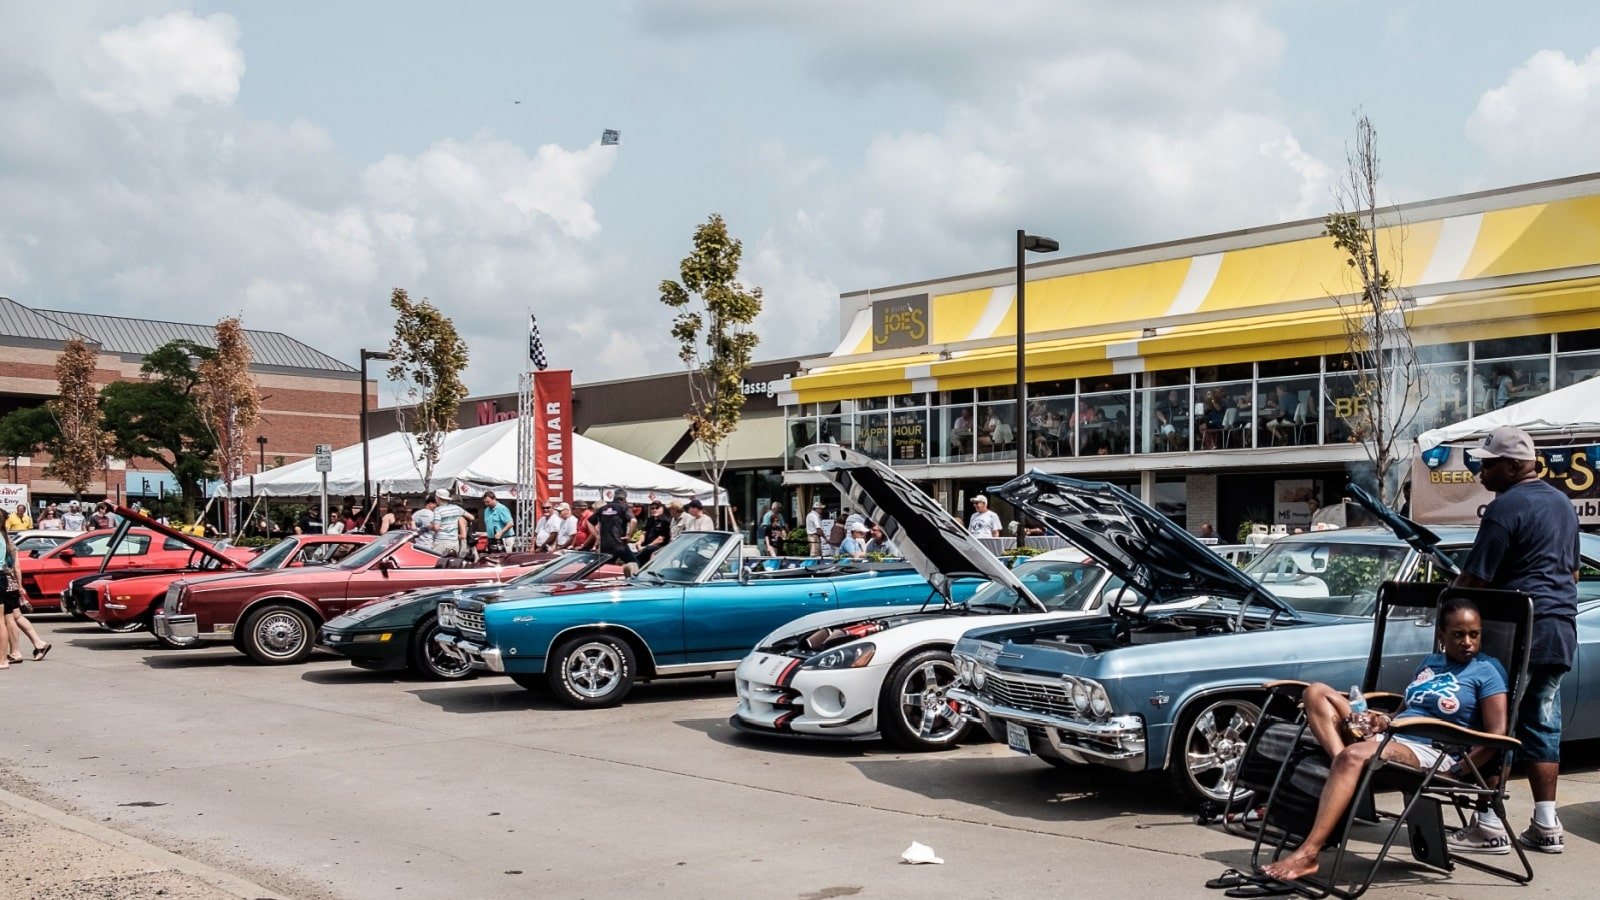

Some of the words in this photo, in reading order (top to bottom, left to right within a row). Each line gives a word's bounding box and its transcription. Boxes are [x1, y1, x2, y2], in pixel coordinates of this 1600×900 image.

[859, 427, 888, 438] HAPPY
[893, 425, 922, 436] HOUR
[546, 402, 564, 502] LINAMAR
[1430, 470, 1476, 484] BEER
